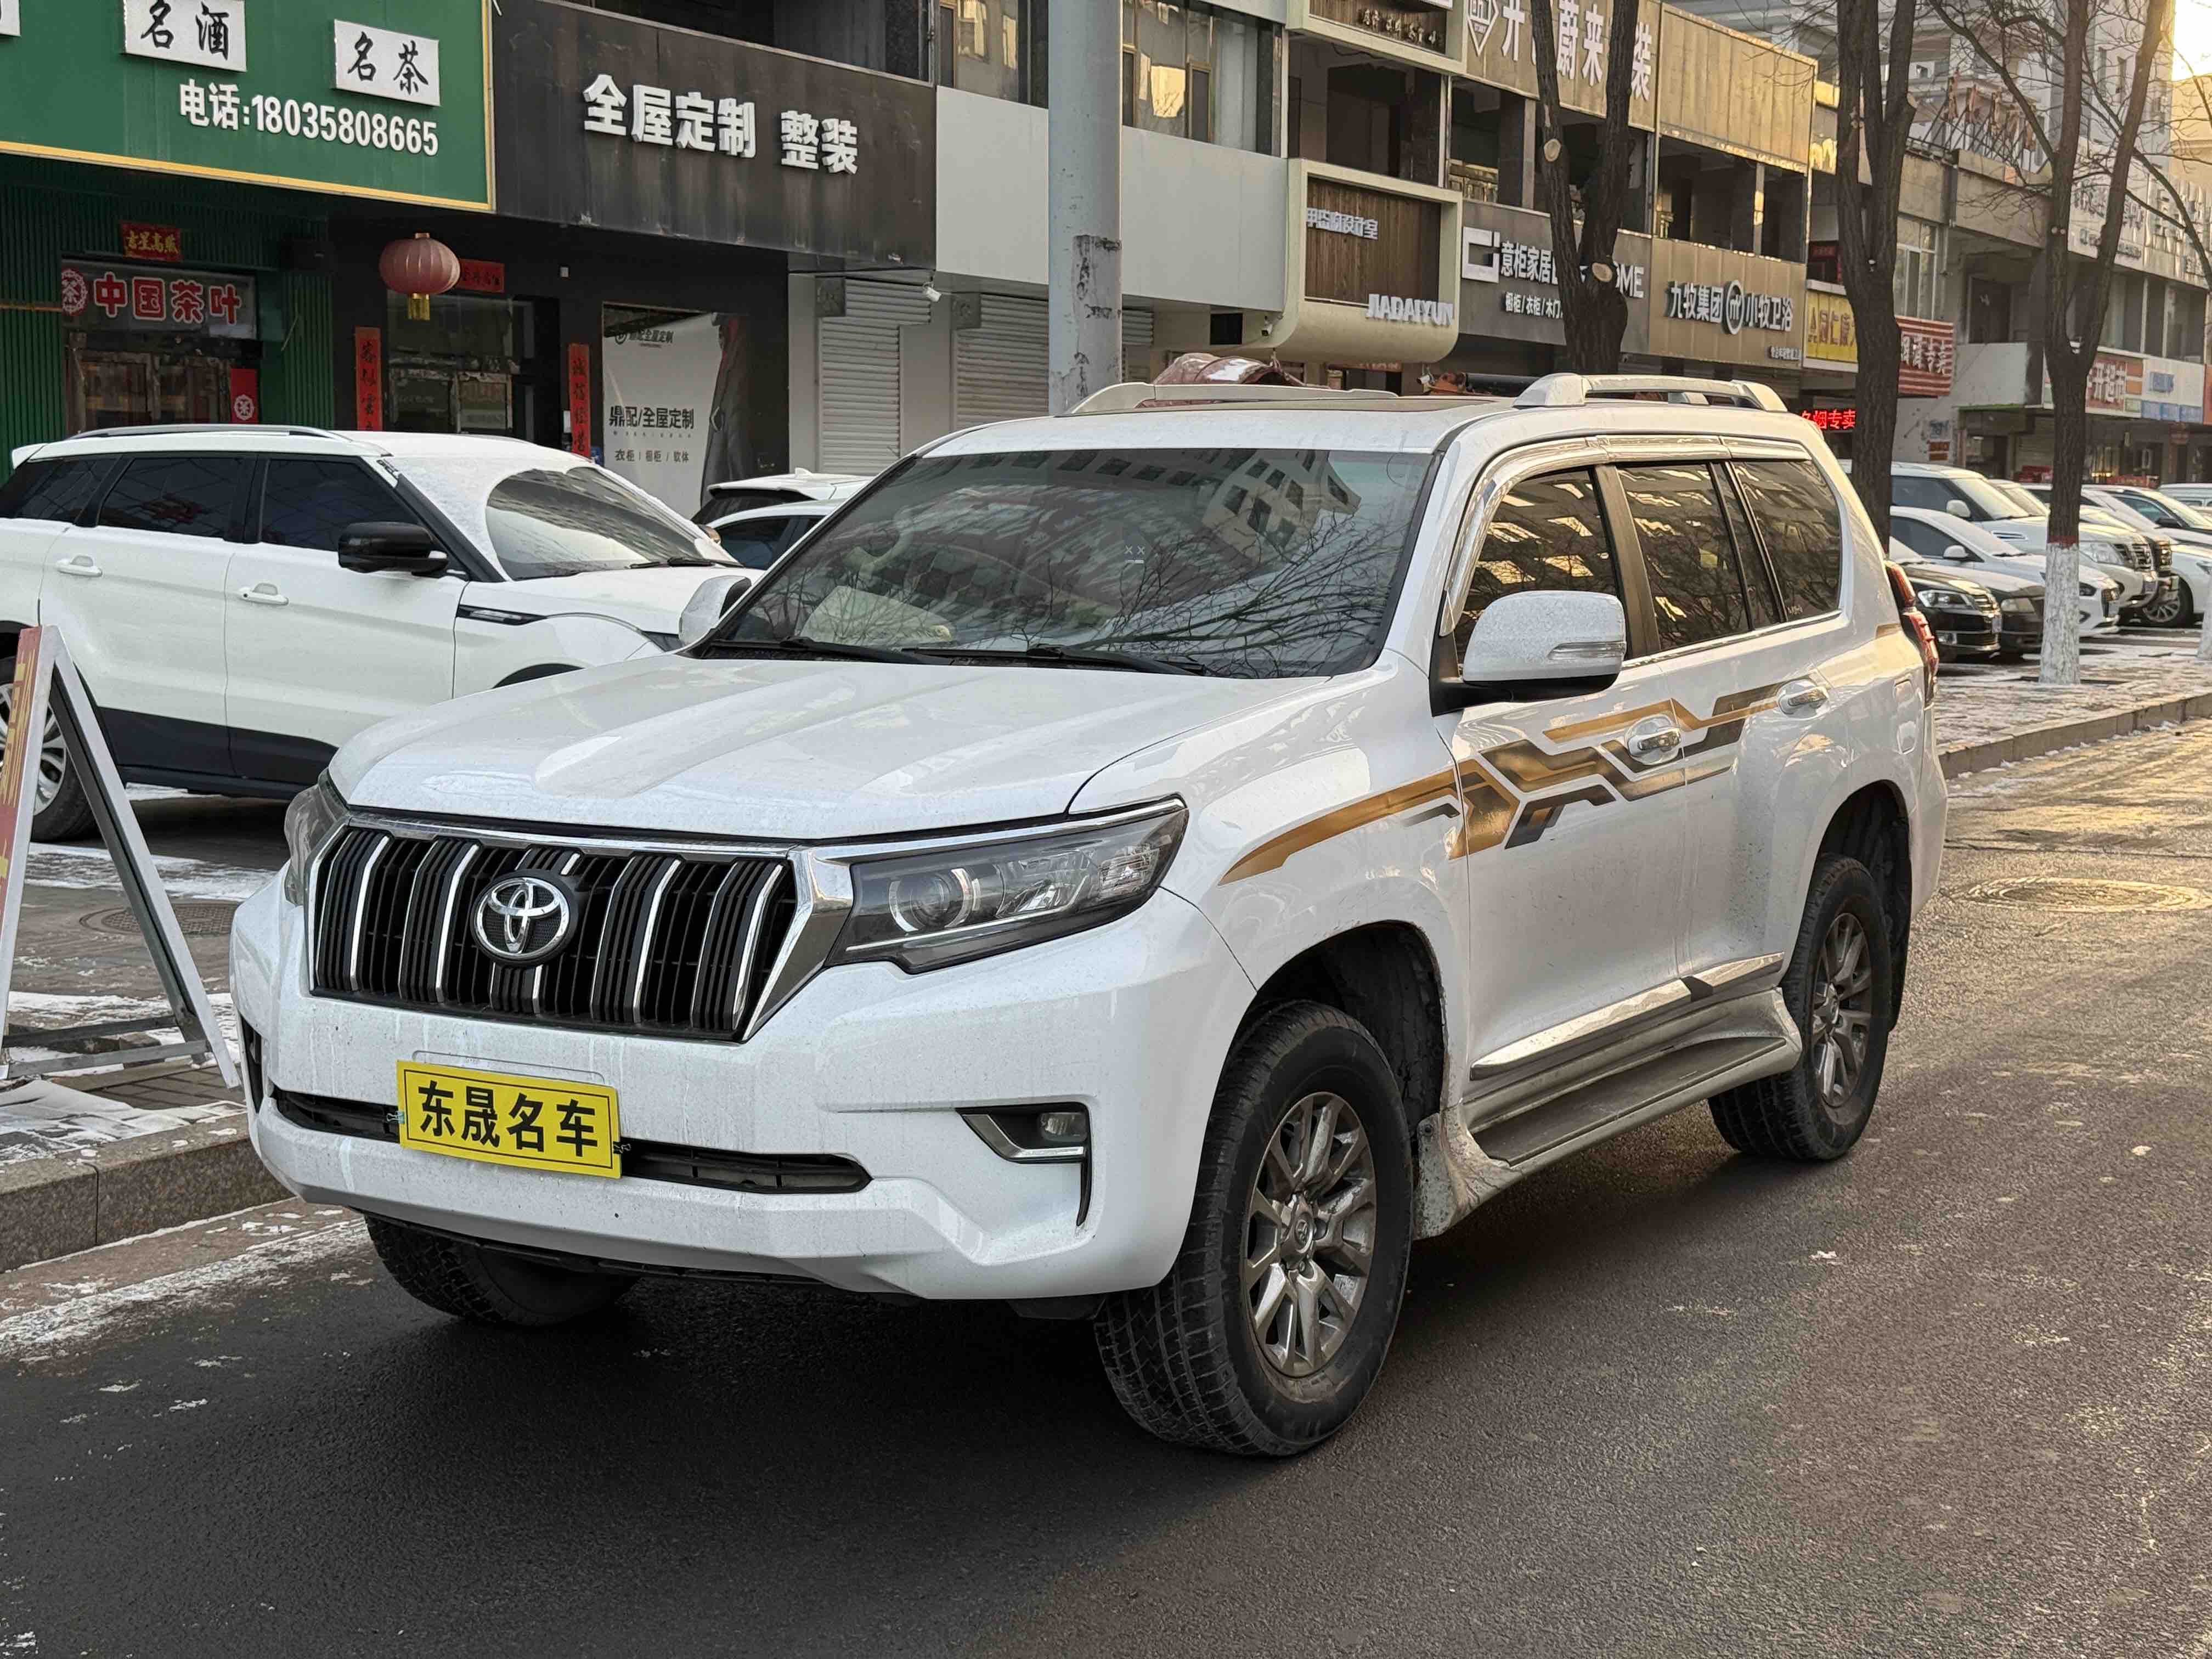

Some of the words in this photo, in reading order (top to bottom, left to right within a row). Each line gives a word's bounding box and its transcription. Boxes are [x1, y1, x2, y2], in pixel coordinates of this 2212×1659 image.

[141, 0, 229, 60] 名酒
[1502, 0, 1652, 101] 开蔚来装
[348, 32, 428, 94] 名茶
[179, 78, 439, 156] 电话:18035808665
[583, 74, 757, 159] 全屋定制
[781, 110, 858, 174] 整装
[1500, 240, 1553, 285] 意柜家居
[93, 271, 241, 325] 中国茶叶
[1365, 294, 1454, 325] JIADAIYUN
[1669, 281, 1724, 323] 九牧集团
[1746, 292, 1793, 331] 小牧卫浴
[417, 1080, 598, 1157] 东晟名车
